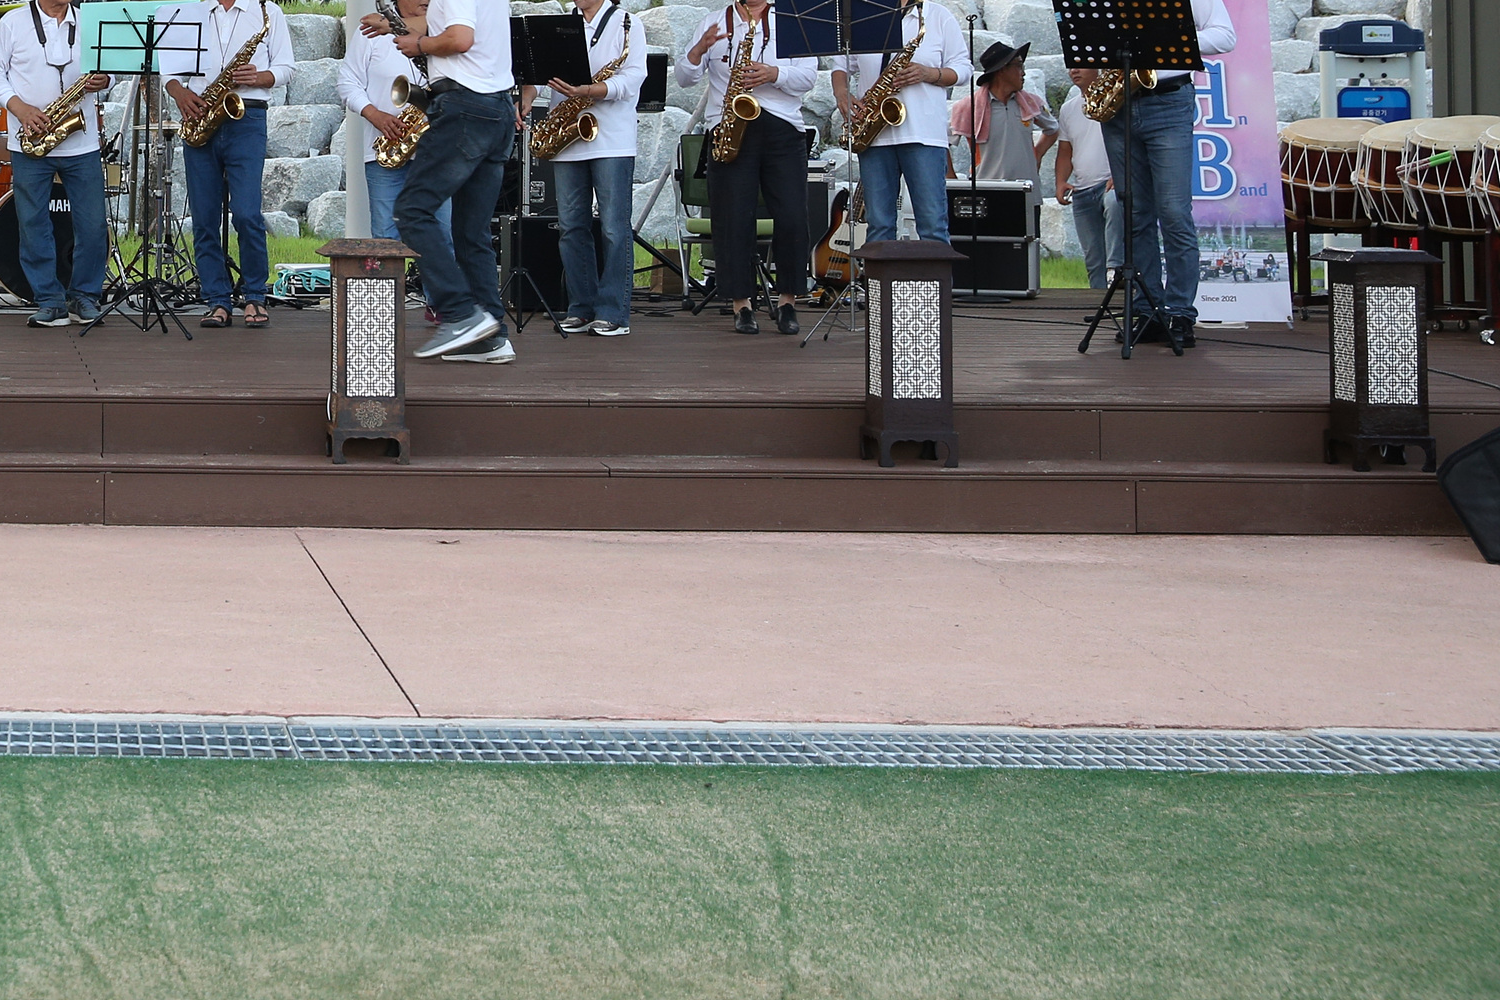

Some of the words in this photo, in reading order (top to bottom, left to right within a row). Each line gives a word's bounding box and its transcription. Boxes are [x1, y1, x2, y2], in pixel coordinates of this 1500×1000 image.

[1192, 131, 1269, 200] Band
[49, 199, 71, 212] MAH
[1200, 294, 1220, 303] Since
[1220, 294, 1237, 303] 2021
